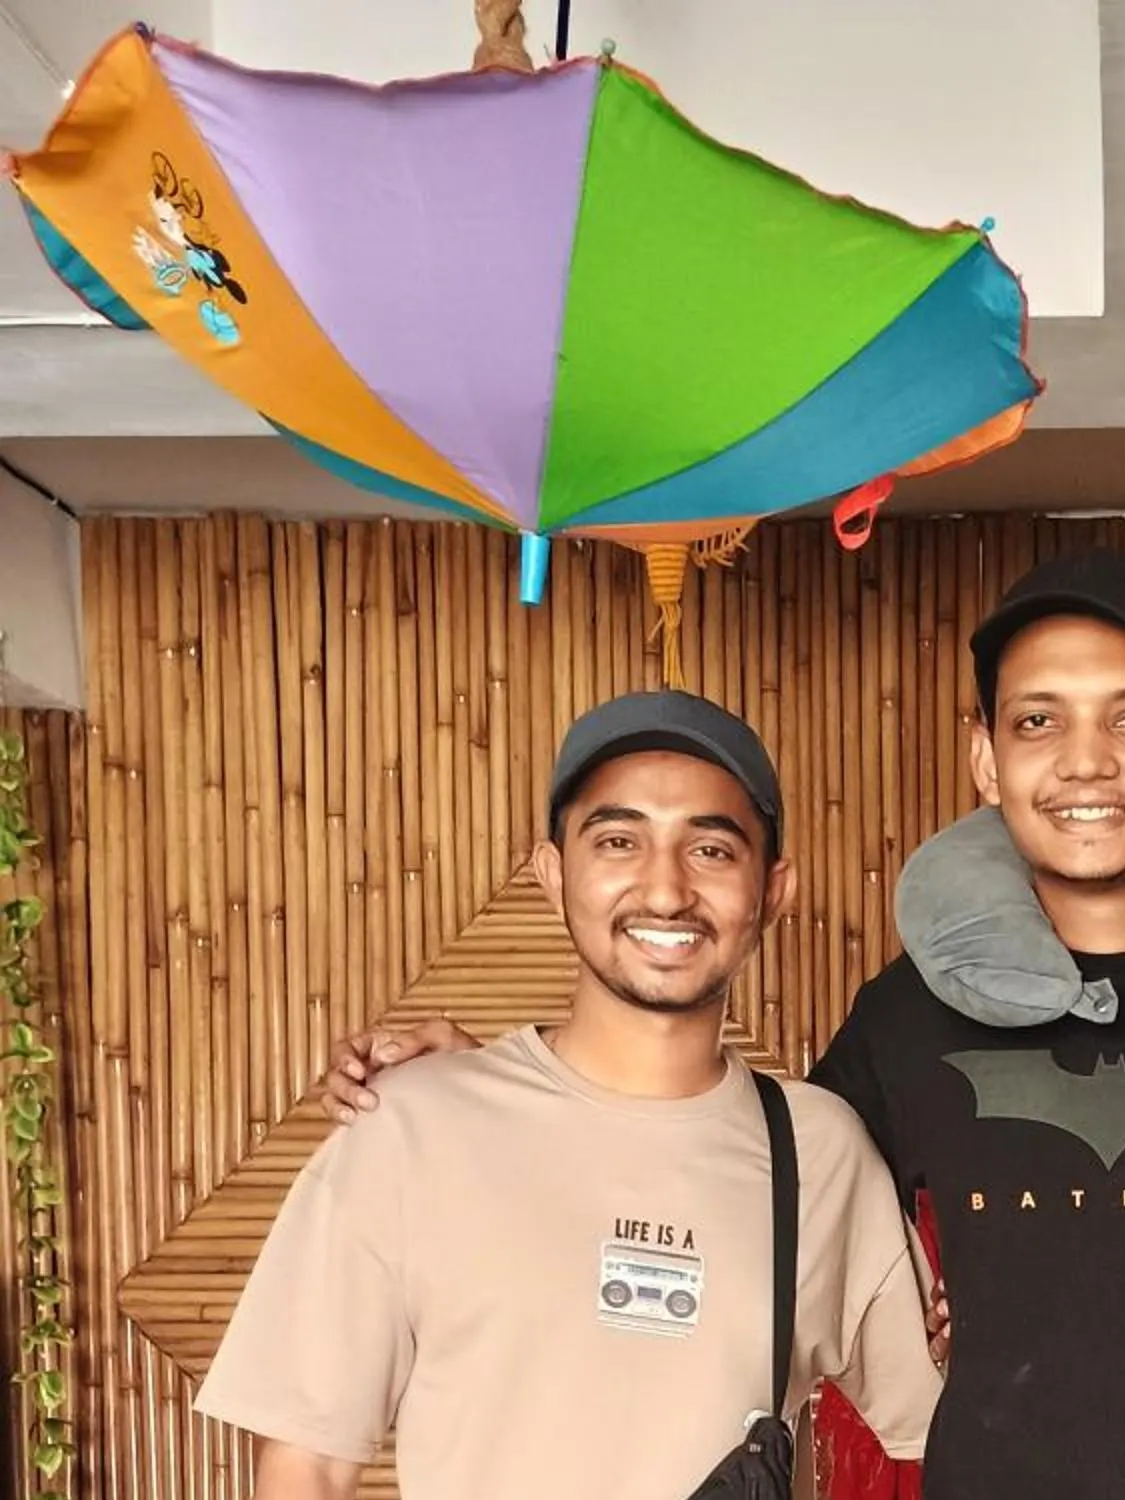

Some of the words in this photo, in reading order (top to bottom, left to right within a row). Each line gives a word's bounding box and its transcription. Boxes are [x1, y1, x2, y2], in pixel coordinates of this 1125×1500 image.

[615, 1217, 651, 1242] LIFE
[657, 1224, 674, 1246] IS
[682, 1229, 695, 1249] A
